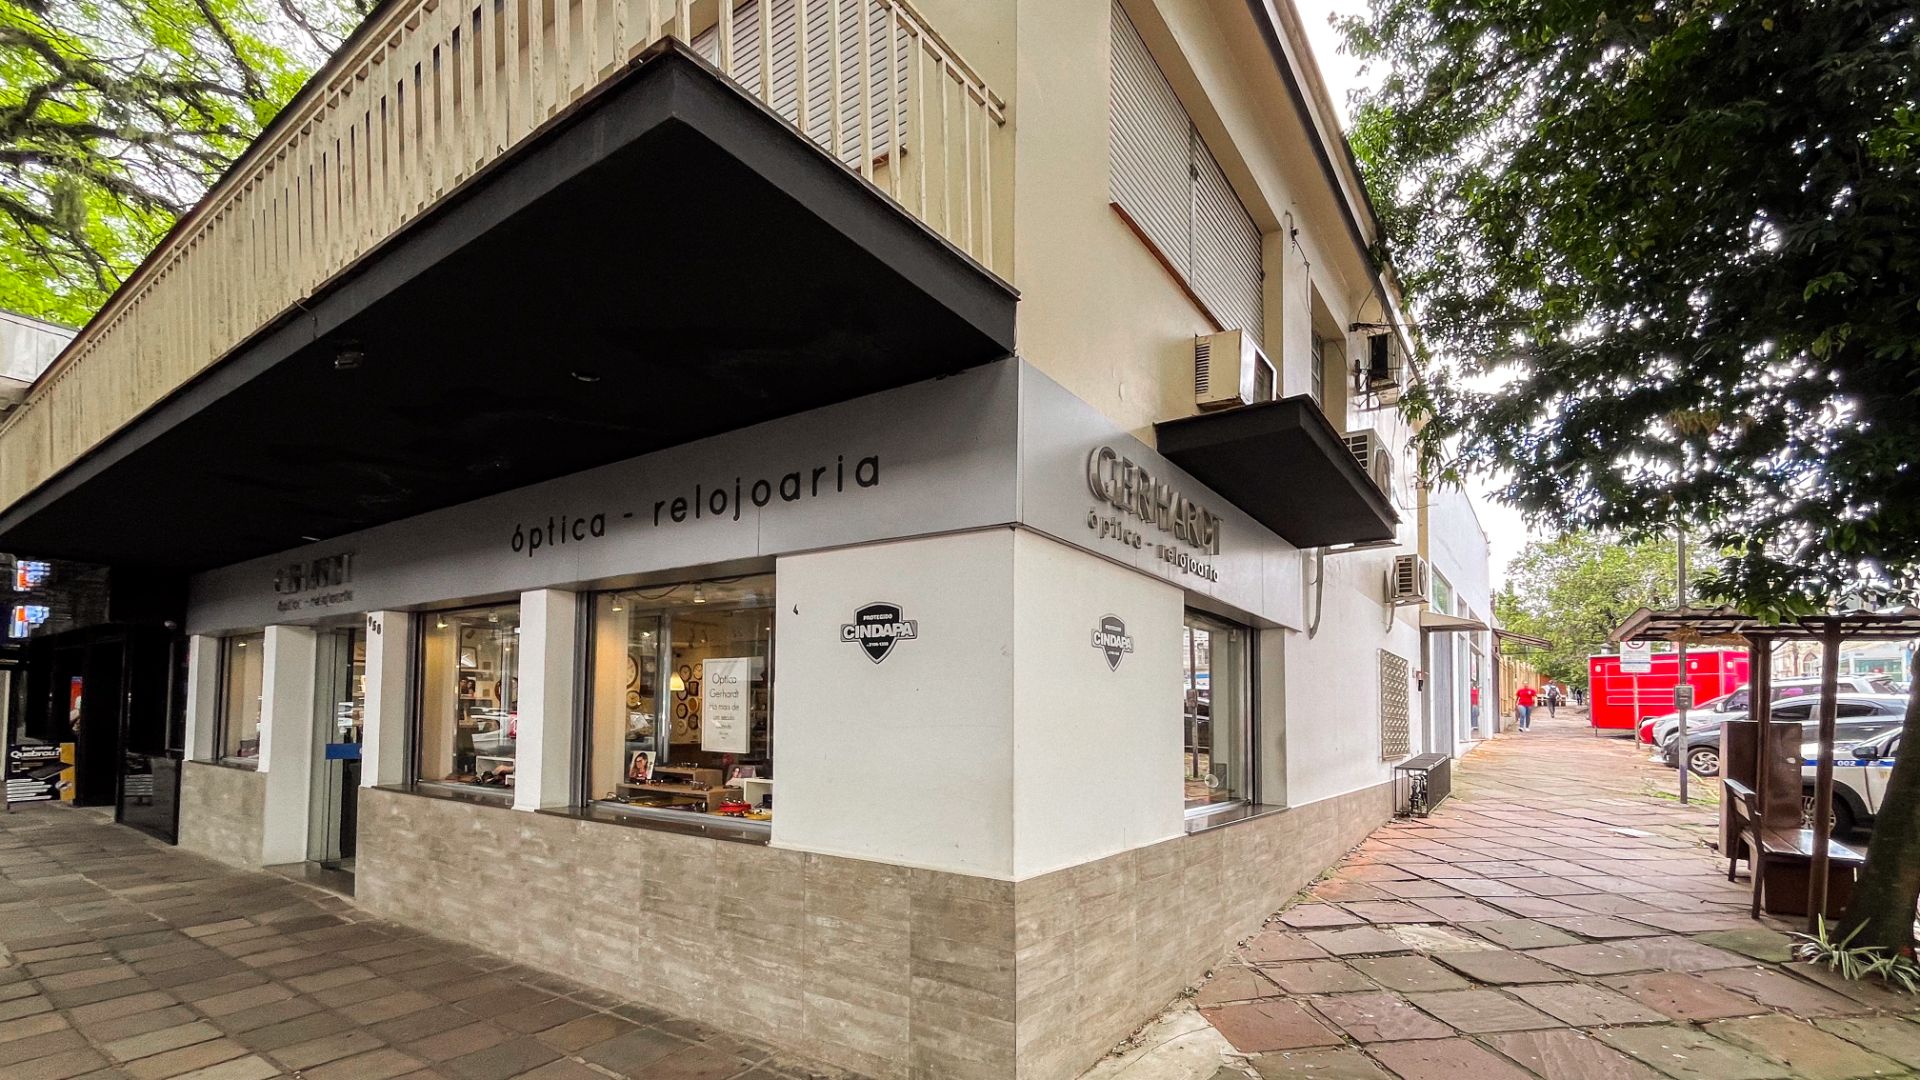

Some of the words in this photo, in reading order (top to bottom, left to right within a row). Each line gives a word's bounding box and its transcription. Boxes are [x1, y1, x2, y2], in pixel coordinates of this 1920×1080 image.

[511, 512, 606, 557] óptica
[653, 454, 880, 527] relojoaria
[1088, 446, 1224, 556] GERHARDT
[1087, 506, 1142, 549] óptica
[1156, 544, 1220, 583] relojoaria
[843, 622, 914, 640] CINDAPA
[1093, 630, 1133, 650] CINDAPA
